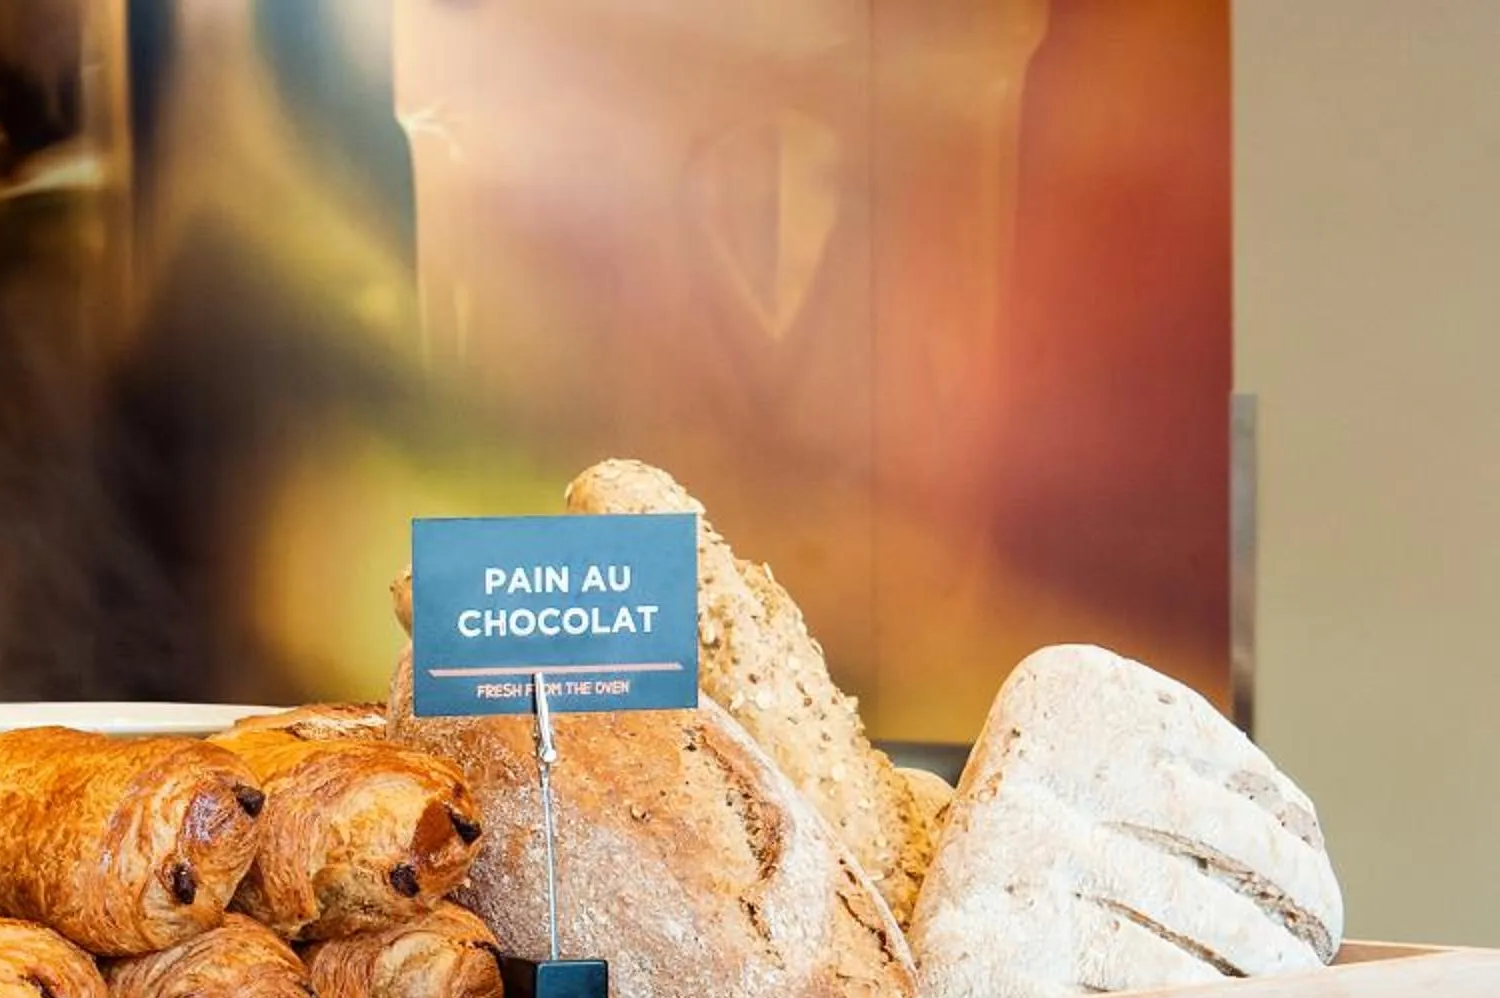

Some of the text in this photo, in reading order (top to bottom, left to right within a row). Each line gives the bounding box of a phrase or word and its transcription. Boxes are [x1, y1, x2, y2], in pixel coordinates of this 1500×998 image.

[484, 565, 631, 594] PAIN AU
[457, 605, 659, 637] CHOCOLAT
[476, 680, 630, 698] FRESH FOM THE OVEN
